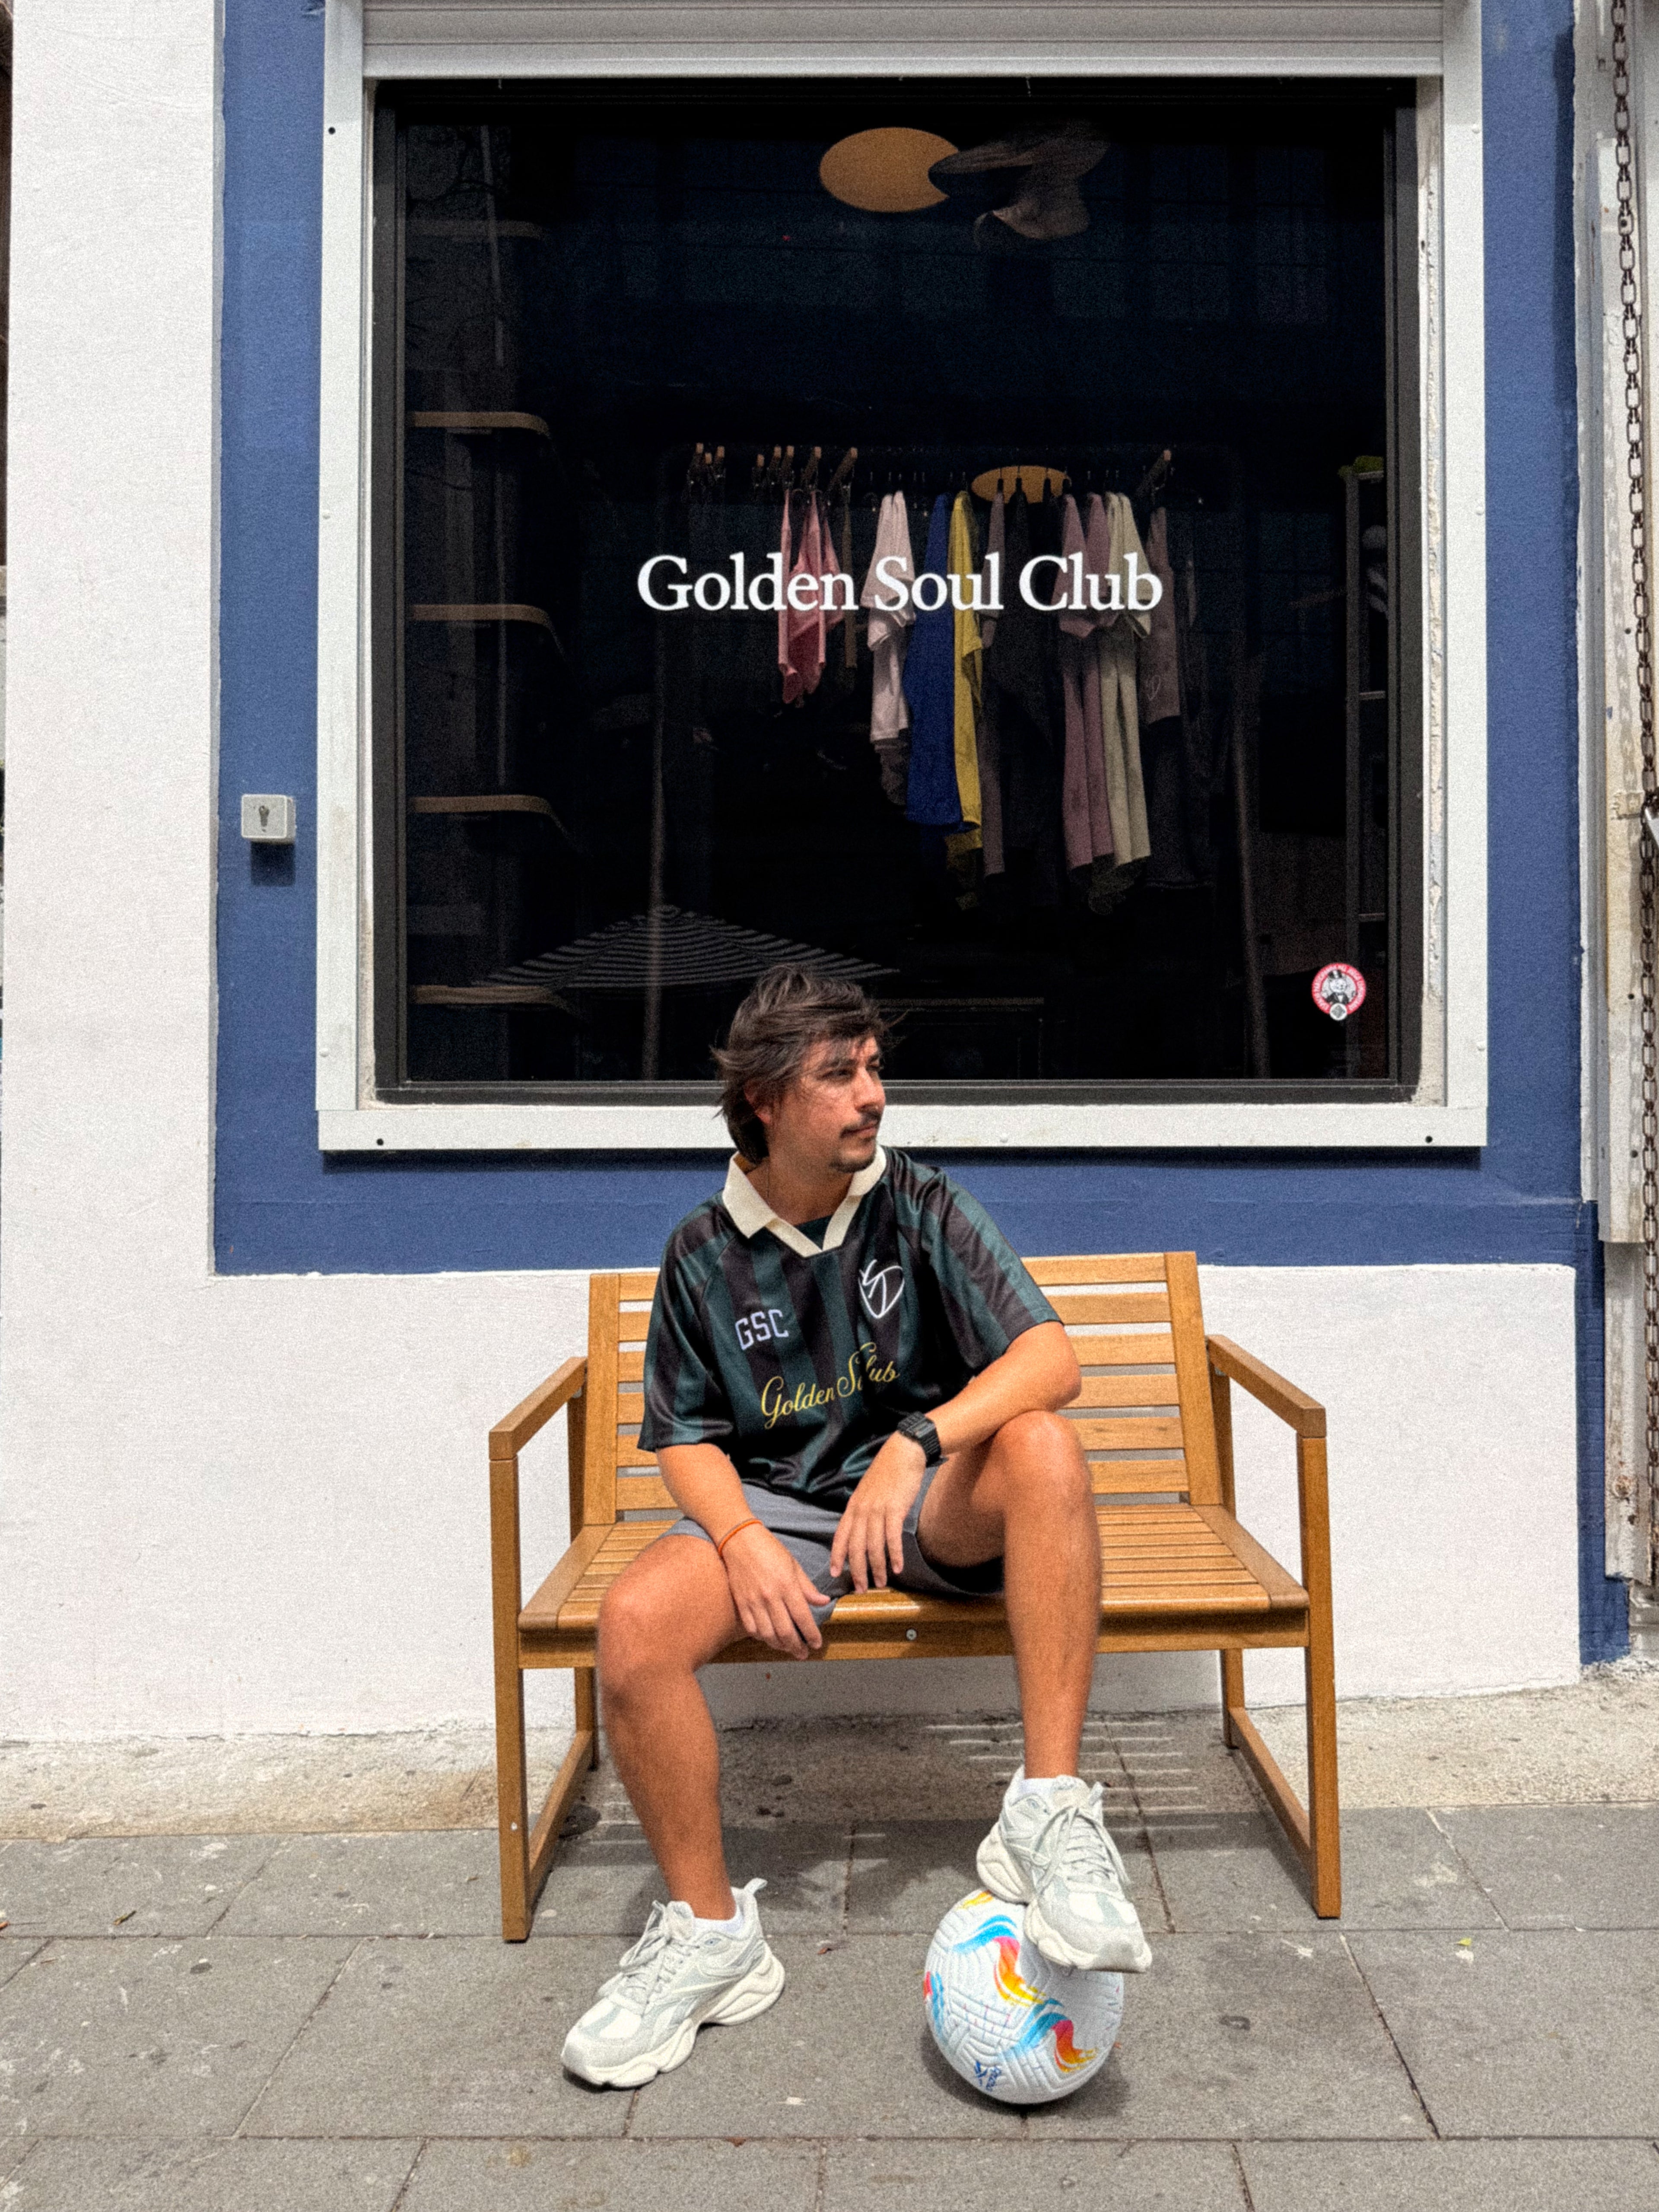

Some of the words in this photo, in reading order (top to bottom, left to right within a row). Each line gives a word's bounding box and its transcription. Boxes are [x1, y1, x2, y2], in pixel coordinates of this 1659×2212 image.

[637, 552, 859, 611] Golden
[874, 552, 1004, 611] Soul
[1019, 552, 1163, 611] Club
[734, 1309, 789, 1351] GSC
[760, 1376, 835, 1430] Golden
